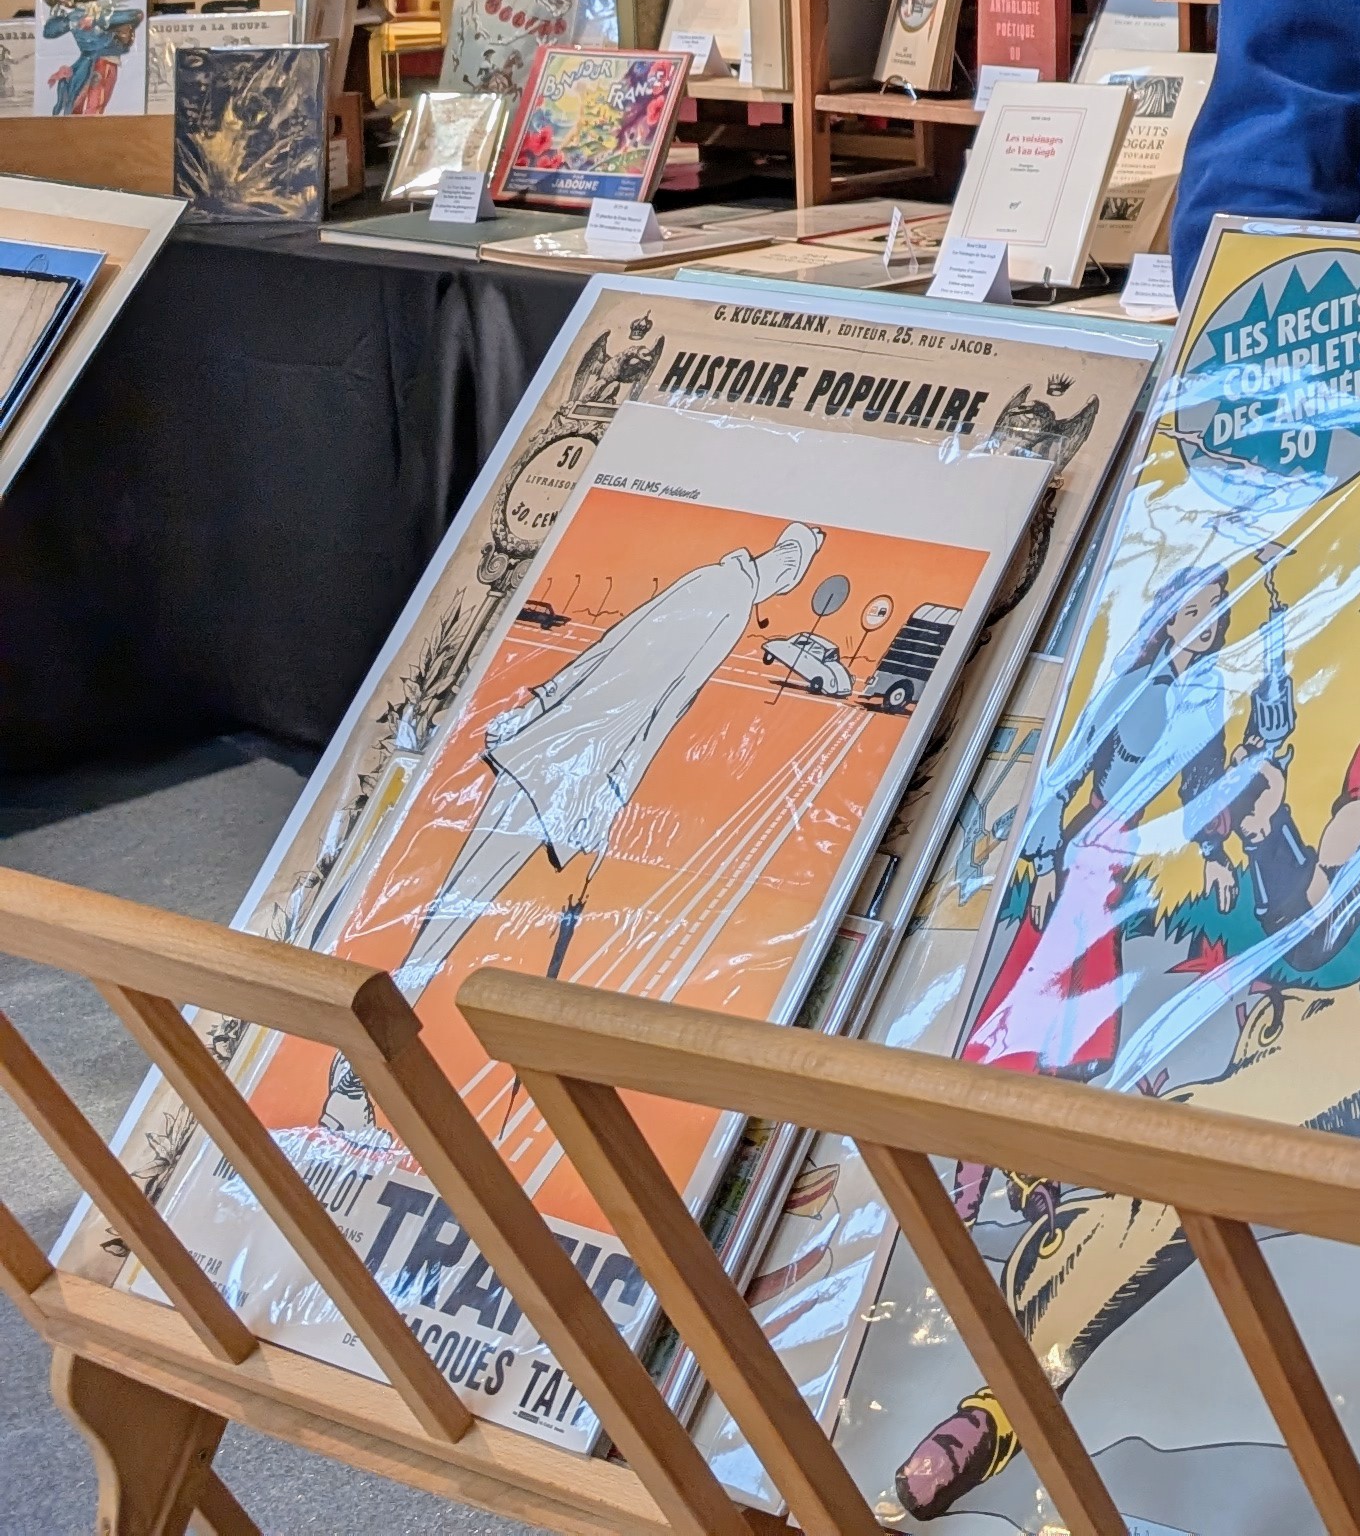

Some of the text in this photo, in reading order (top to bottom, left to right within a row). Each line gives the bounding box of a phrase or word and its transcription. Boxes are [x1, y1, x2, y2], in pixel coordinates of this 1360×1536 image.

[990, 0, 1040, 15] ANTHOLOGIE
[996, 20, 1035, 40] POÉTIQUE
[1010, 47, 1021, 60] OU
[542, 59, 613, 103] BONJOUR
[607, 64, 675, 111] FRANCE!
[1006, 133, 1019, 143] Les
[1006, 147, 1015, 155] de
[1035, 147, 1056, 158] Gogh
[552, 179, 599, 192] JABOUNE
[714, 305, 727, 321] G.
[729, 307, 831, 336] KUGELMANN,
[918, 334, 945, 349] RUE
[950, 340, 998, 356] JACOB.
[1224, 321, 1268, 364] LES
[658, 352, 989, 435] HISTOIRE POPULAIRE
[1214, 401, 1263, 446] DES
[1280, 425, 1316, 464] 50
[557, 446, 583, 470] 50
[594, 474, 627, 488] BELGA
[631, 479, 662, 493] FILMS
[342, 1333, 359, 1346] DE
